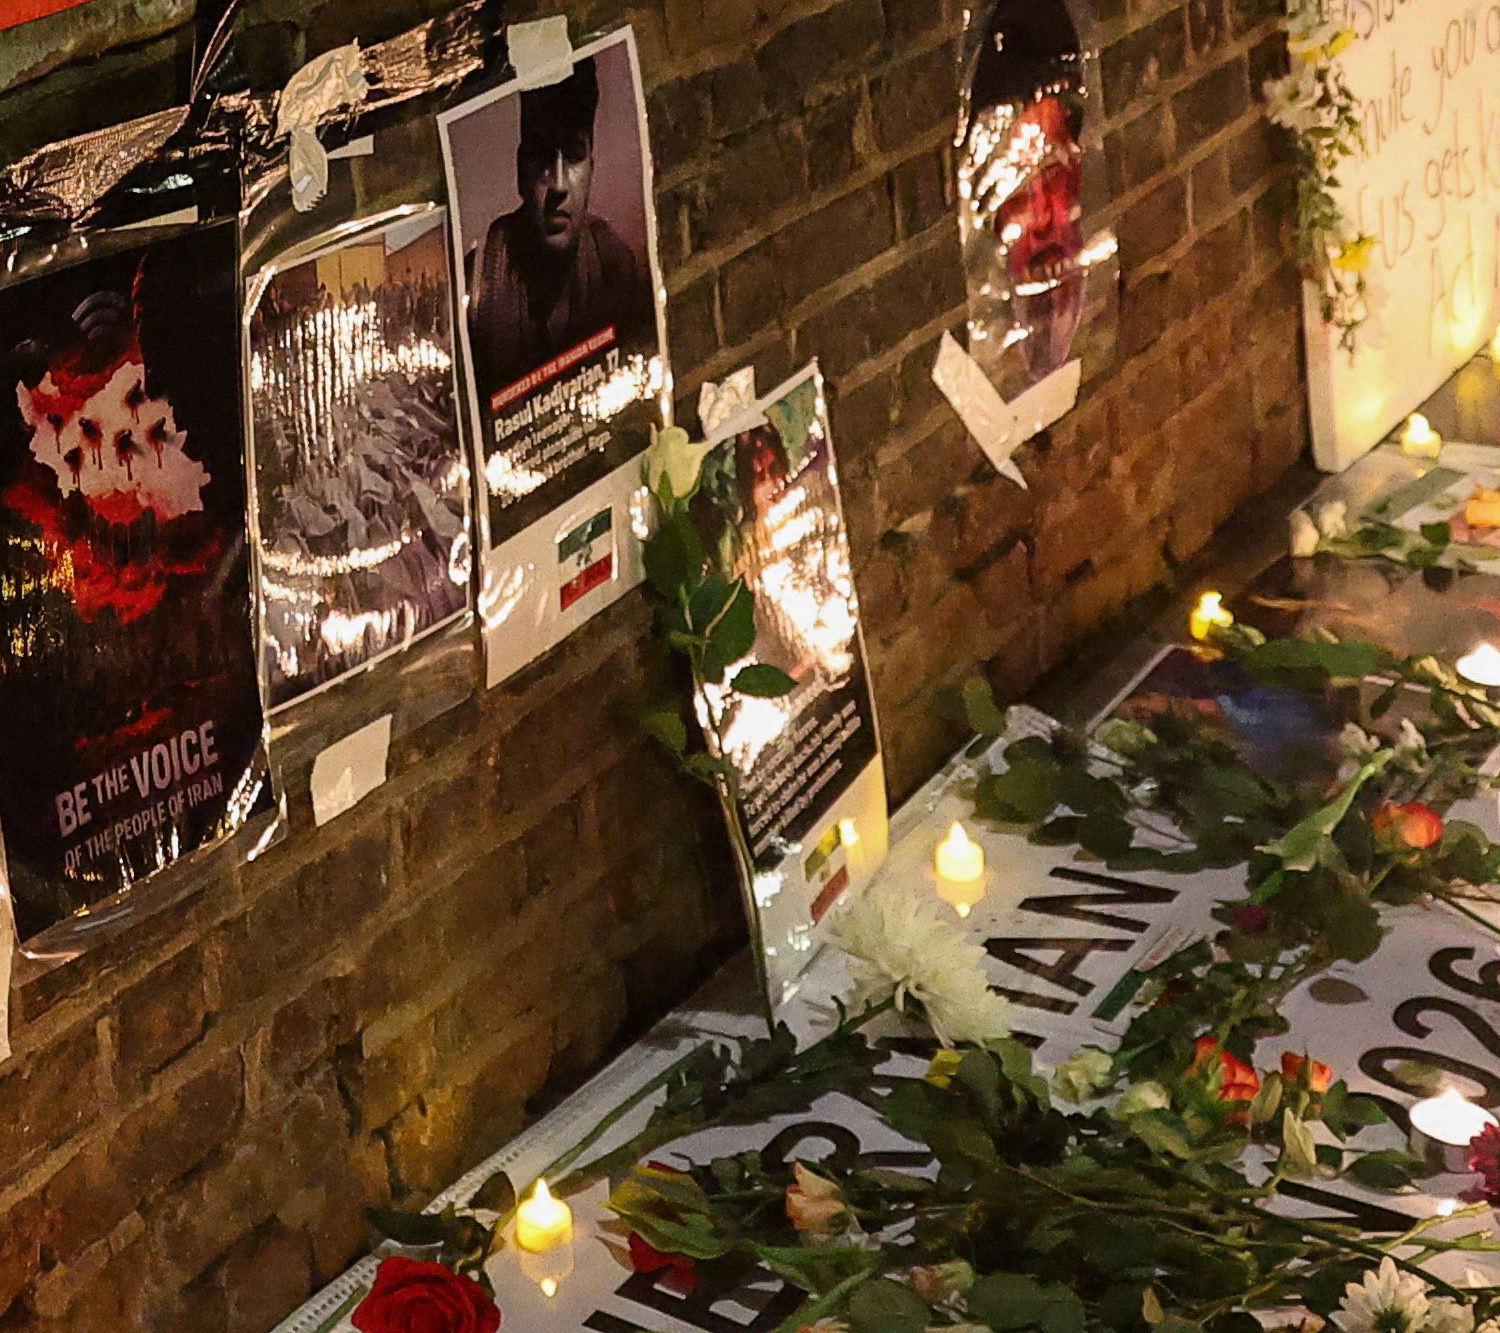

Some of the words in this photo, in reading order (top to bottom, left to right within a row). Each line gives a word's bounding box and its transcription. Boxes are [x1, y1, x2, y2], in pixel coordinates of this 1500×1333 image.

[494, 399, 534, 443] Rasul
[54, 780, 93, 839] BE
[91, 765, 131, 806] THE
[130, 719, 219, 800] VOICE
[85, 828, 115, 861] THE
[114, 800, 168, 846] PEOPLE
[168, 790, 186, 817] OF
[187, 770, 225, 808] IRAN
